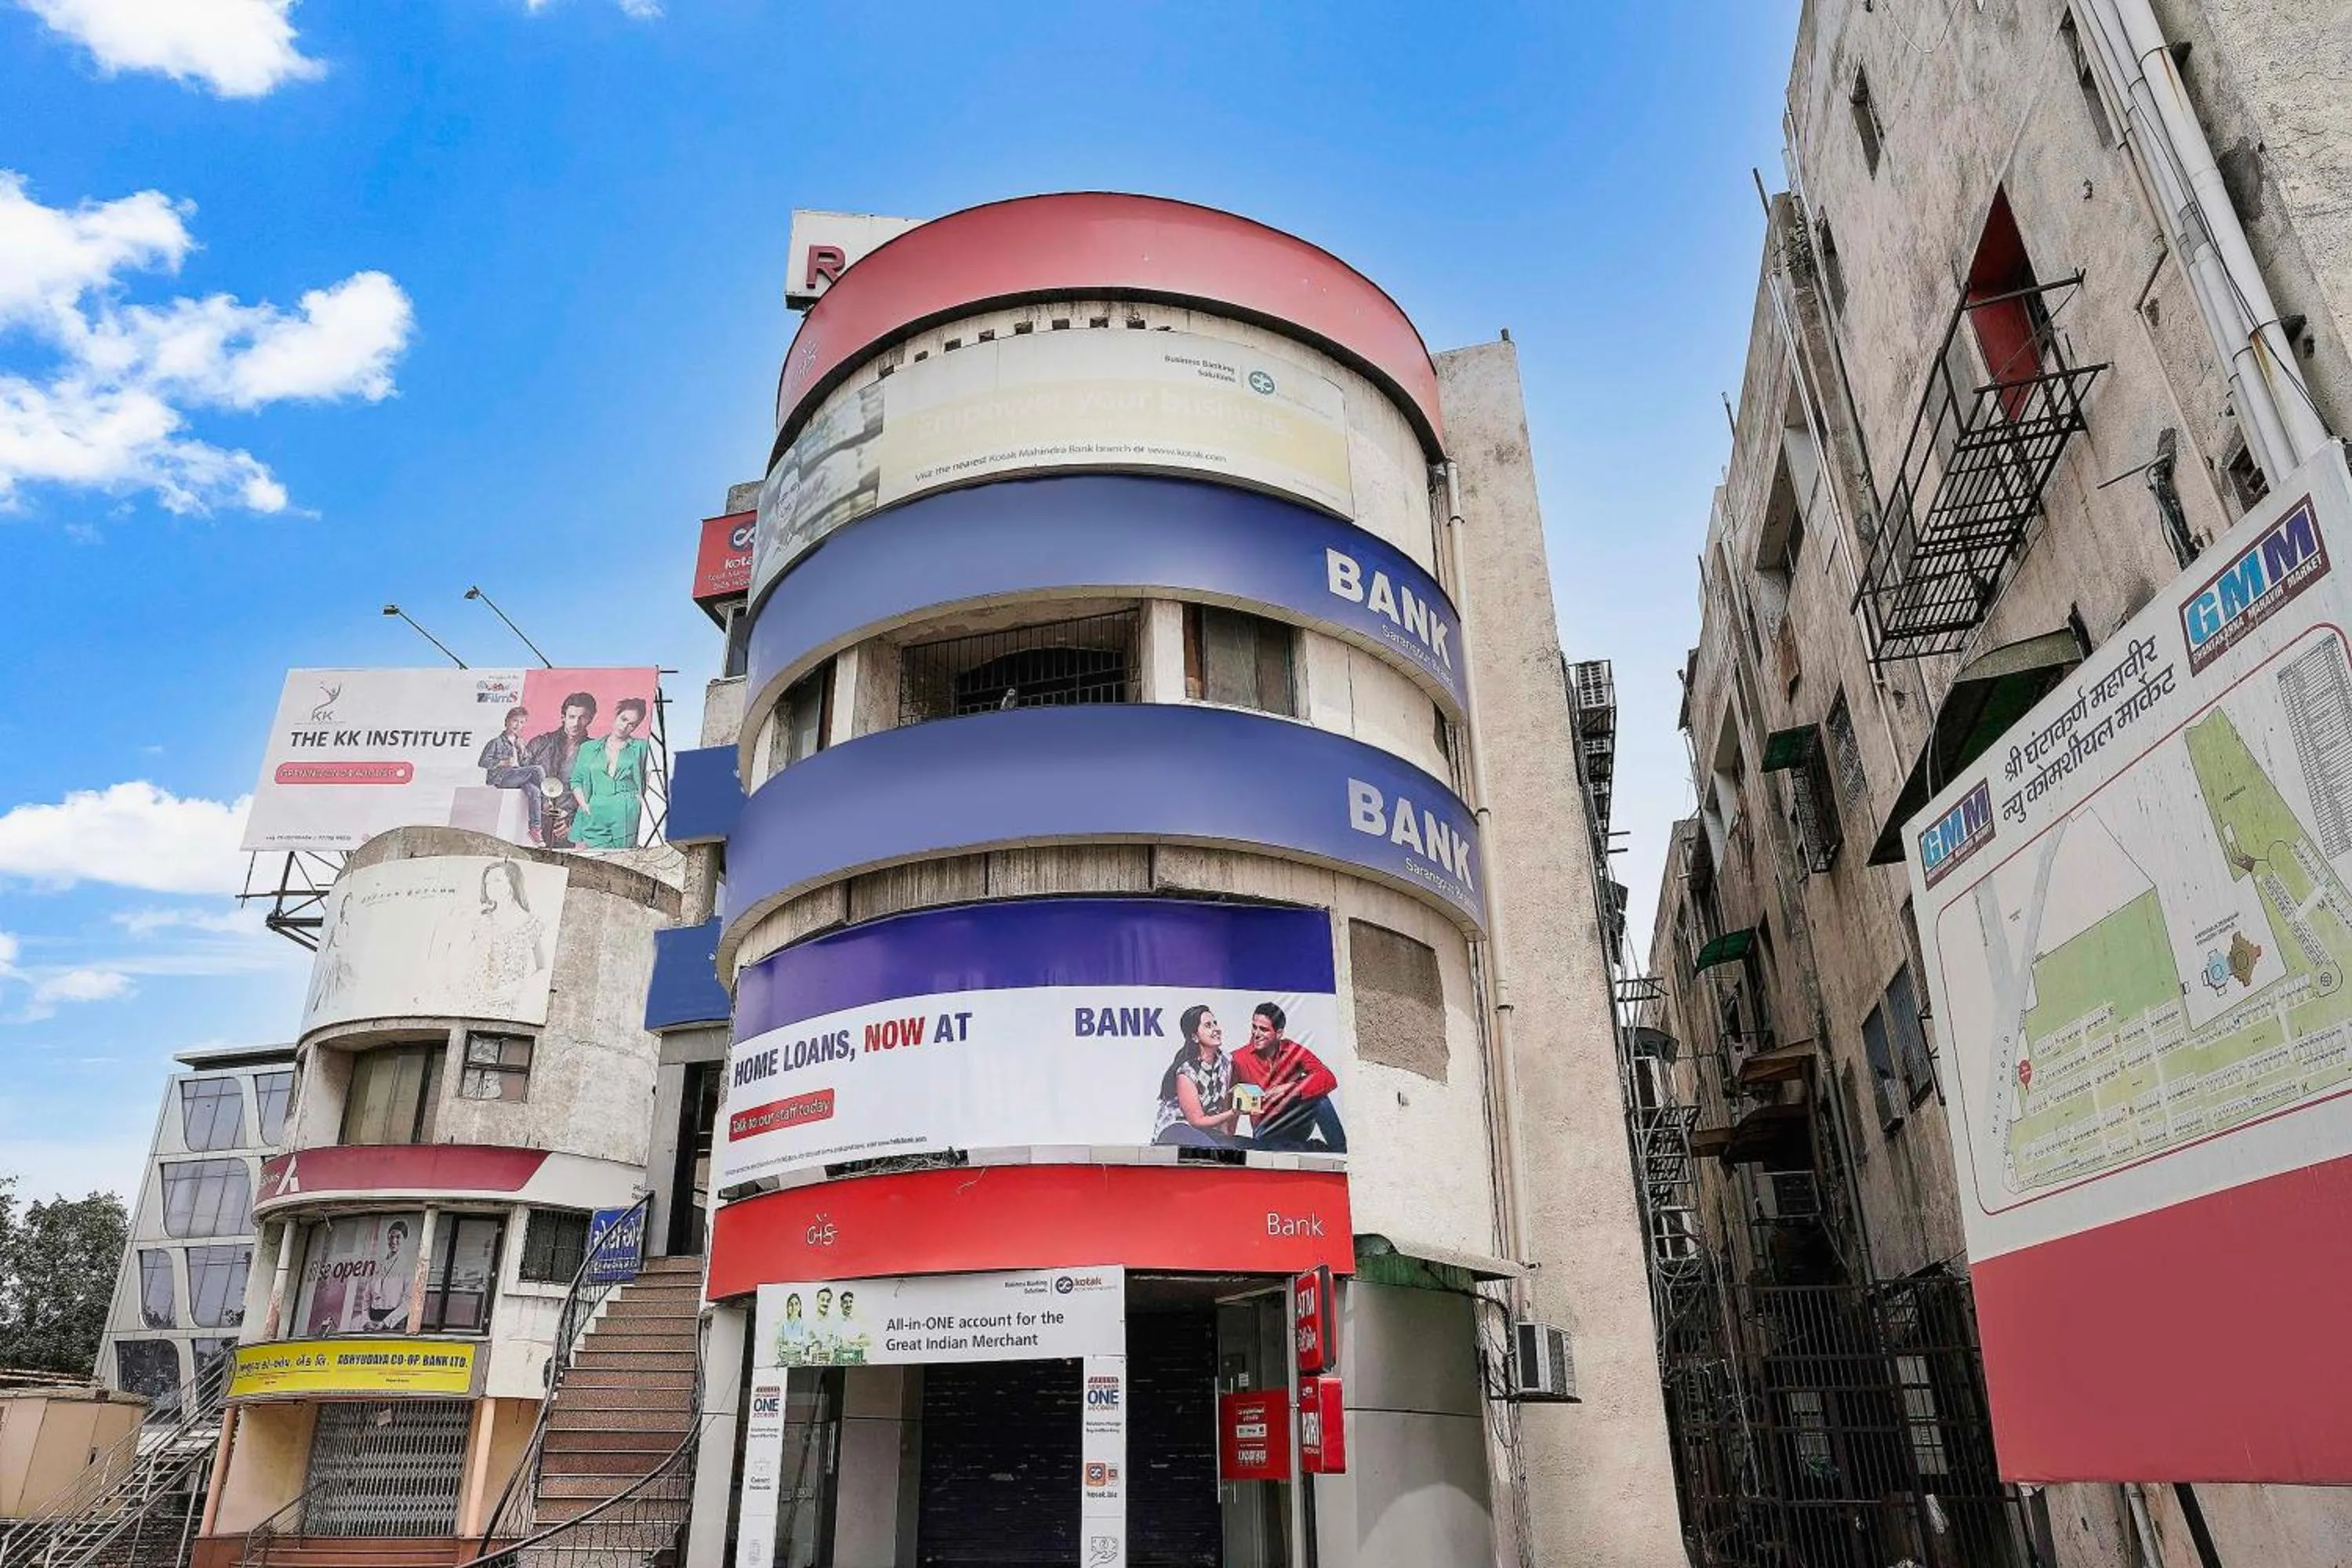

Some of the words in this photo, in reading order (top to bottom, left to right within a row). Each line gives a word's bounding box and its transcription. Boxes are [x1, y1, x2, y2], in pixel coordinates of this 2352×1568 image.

[1018, 446, 1067, 459] Mahindra
[1068, 443, 1094, 453] Bank
[2187, 508, 2318, 644] GMM
[2287, 554, 2323, 588] MARKET
[1326, 547, 1453, 671] BANK
[2115, 663, 2176, 729] मार्केट
[2005, 746, 2023, 782] श्री
[2024, 686, 2087, 764] घंटाकर्ण
[2089, 636, 2159, 708] महावीर
[290, 731, 328, 747] THE
[333, 730, 361, 746] KK
[366, 730, 472, 747] INSTITUTE
[1348, 777, 1475, 892] BANK
[1922, 786, 1989, 867] GMM
[733, 1048, 778, 1088] HOME
[782, 1029, 855, 1072] LOANS,
[864, 1016, 926, 1053] NOW
[933, 1011, 973, 1044] AT
[1075, 1007, 1164, 1036] BANK
[748, 1117, 757, 1129] to
[758, 1112, 775, 1126] our
[776, 1105, 797, 1121] staff
[798, 1099, 829, 1116] today
[1267, 1212, 1324, 1236] Bank
[333, 1260, 376, 1283] open
[1075, 1277, 1102, 1287] kotak
[886, 1316, 955, 1331] All-in-ONE
[958, 1313, 1013, 1330] account
[1016, 1312, 1039, 1327] for
[1040, 1311, 1065, 1325] the
[886, 1338, 923, 1352] Great
[926, 1336, 968, 1350] Indian
[971, 1333, 1039, 1348] Merchant
[337, 1354, 390, 1365] ABHYUDAYA
[423, 1355, 448, 1367] BANK
[449, 1356, 468, 1368] LTD.
[753, 1399, 779, 1412] ONE
[1088, 1390, 1119, 1404] ONE
